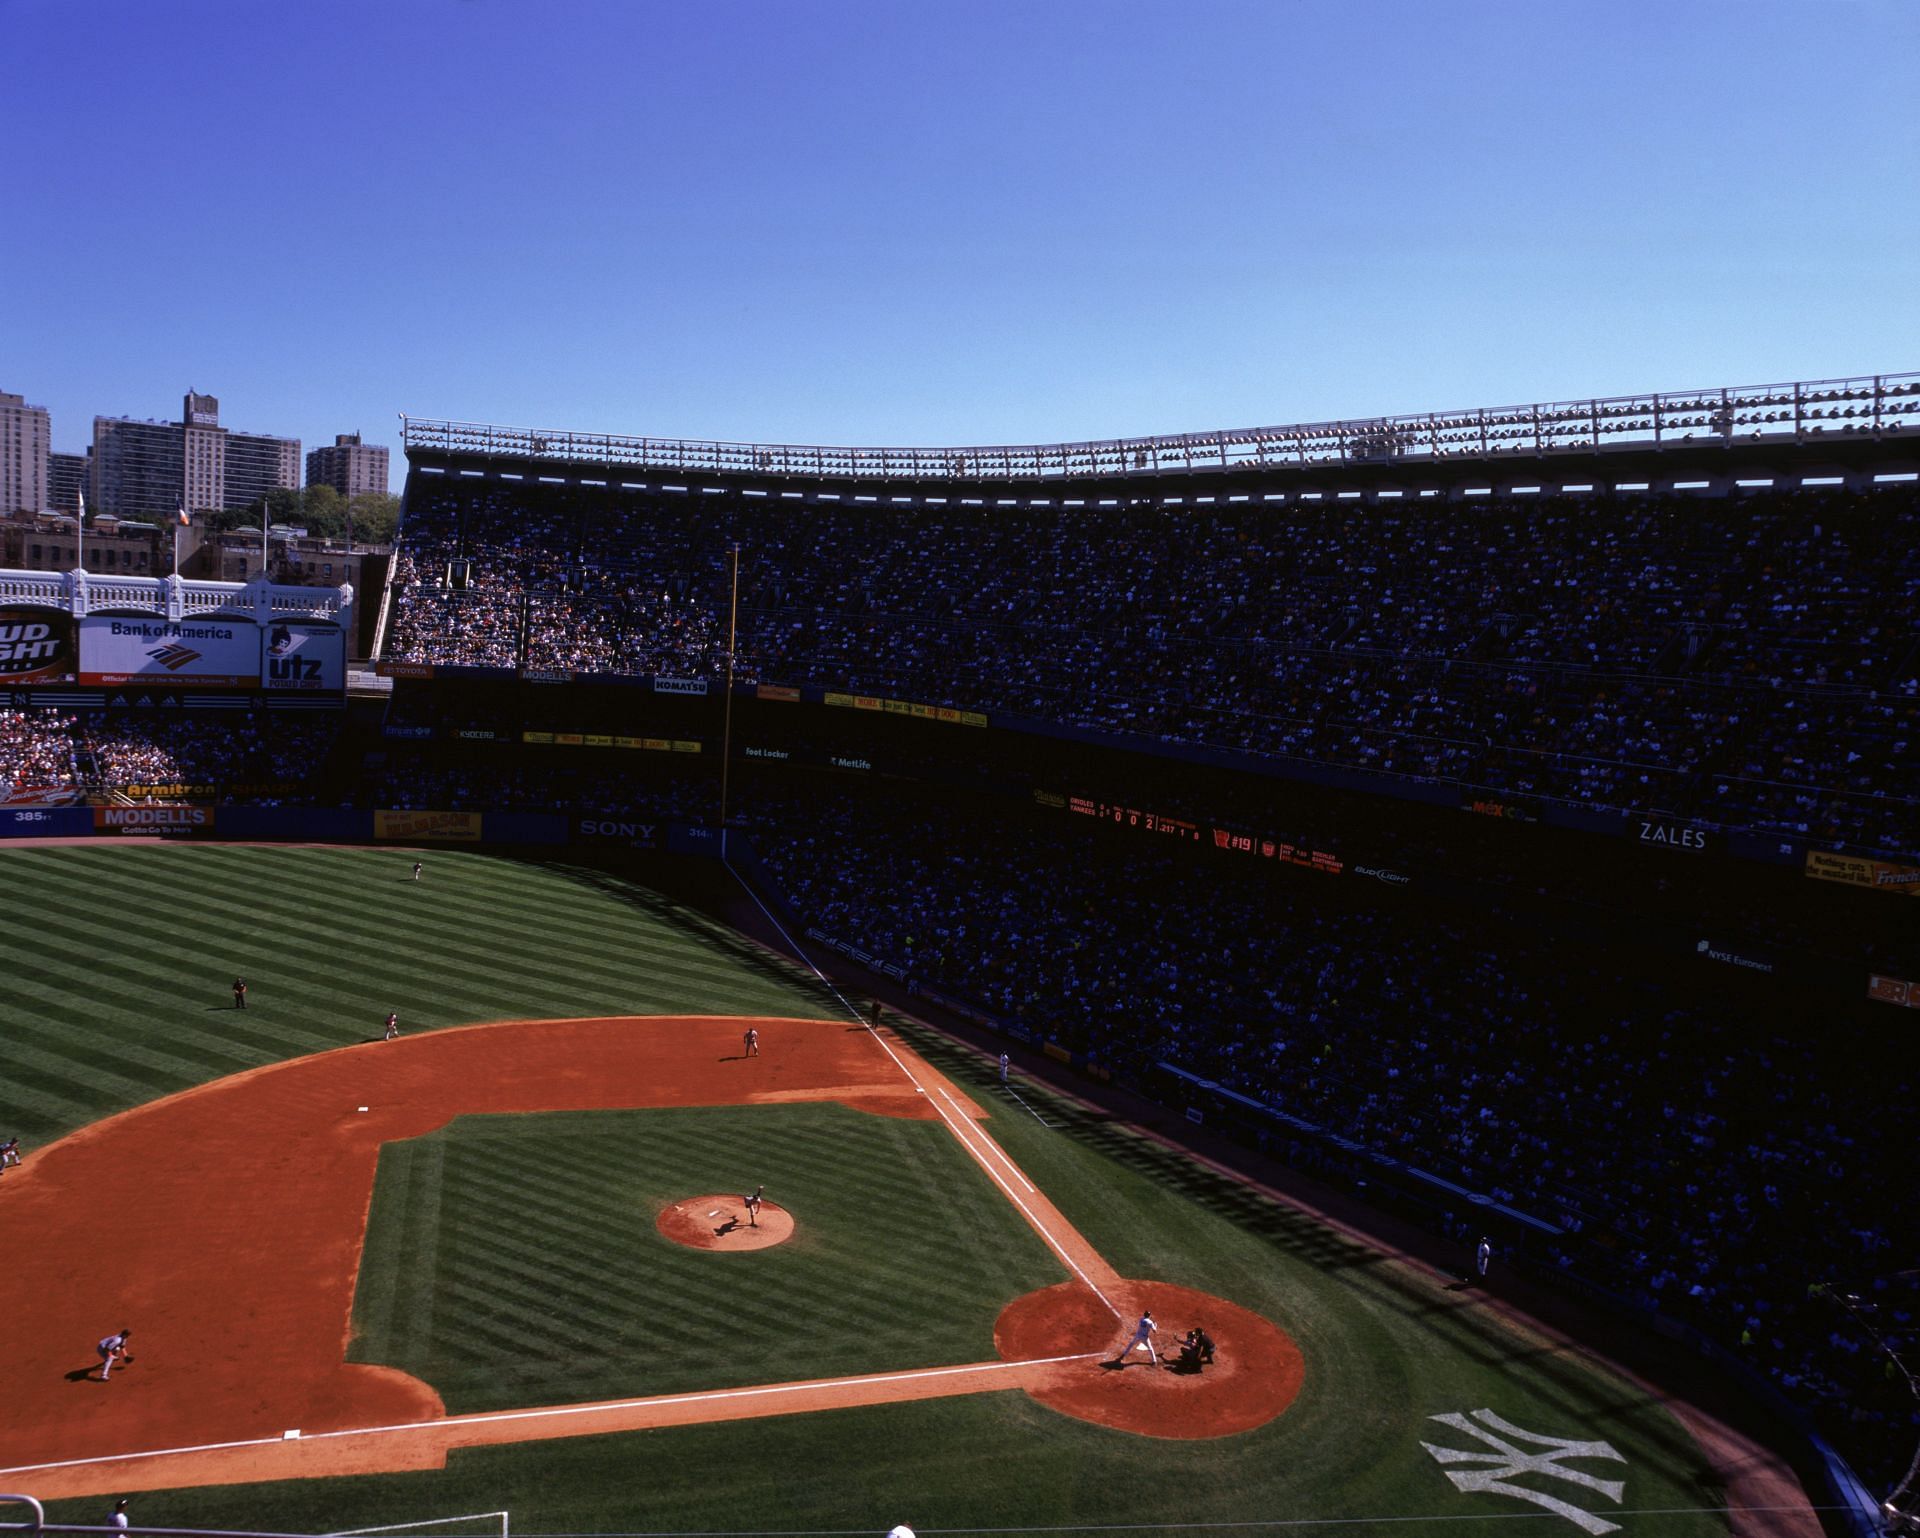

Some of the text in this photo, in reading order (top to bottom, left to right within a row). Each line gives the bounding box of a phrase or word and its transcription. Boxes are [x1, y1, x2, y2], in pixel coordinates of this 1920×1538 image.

[111, 622, 232, 640] Bank of America
[395, 667, 427, 675] TOYOTA
[656, 681, 706, 692] KOMATSU
[745, 747, 790, 760] Foot Locker
[838, 758, 871, 770] MetLife
[128, 784, 216, 797] Armitron
[104, 809, 206, 825] MODELL'S
[1070, 804, 1096, 816] YANKEES
[1115, 812, 1122, 822] 0
[1130, 815, 1137, 826] 0
[1146, 818, 1153, 830] 2
[580, 820, 657, 839] SONY
[1640, 822, 1706, 849] ZALES
[1232, 835, 1251, 852] #19
[1354, 865, 1376, 876] BUD
[1814, 855, 1866, 872] Nothing cuts
[1807, 865, 1871, 883] the mustard like
[1708, 950, 1733, 964] NYSE
